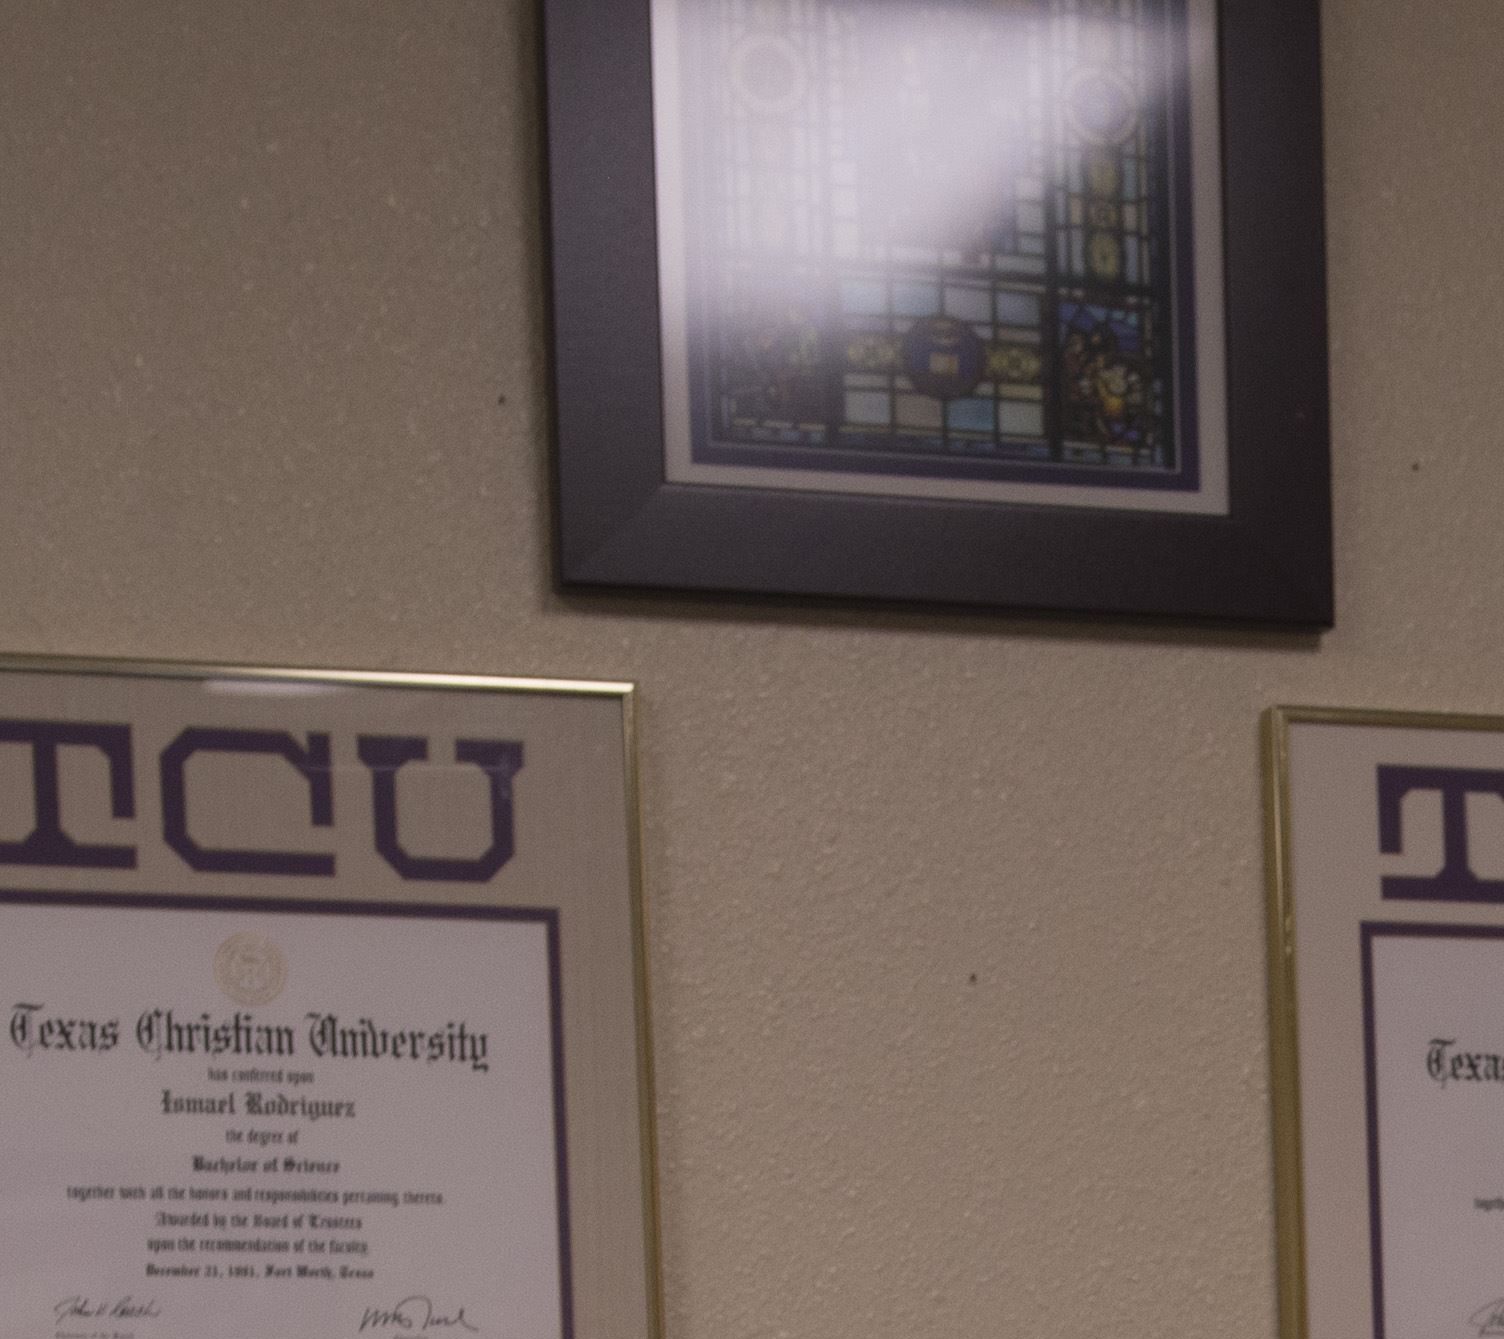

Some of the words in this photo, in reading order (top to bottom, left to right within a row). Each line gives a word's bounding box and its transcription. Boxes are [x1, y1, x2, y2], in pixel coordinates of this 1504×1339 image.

[10, 1003, 119, 1059] Texas
[136, 1008, 295, 1062] Christian
[306, 1011, 489, 1072] University
[161, 1090, 236, 1115] Ismael
[245, 1092, 355, 1121] Rodriguez
